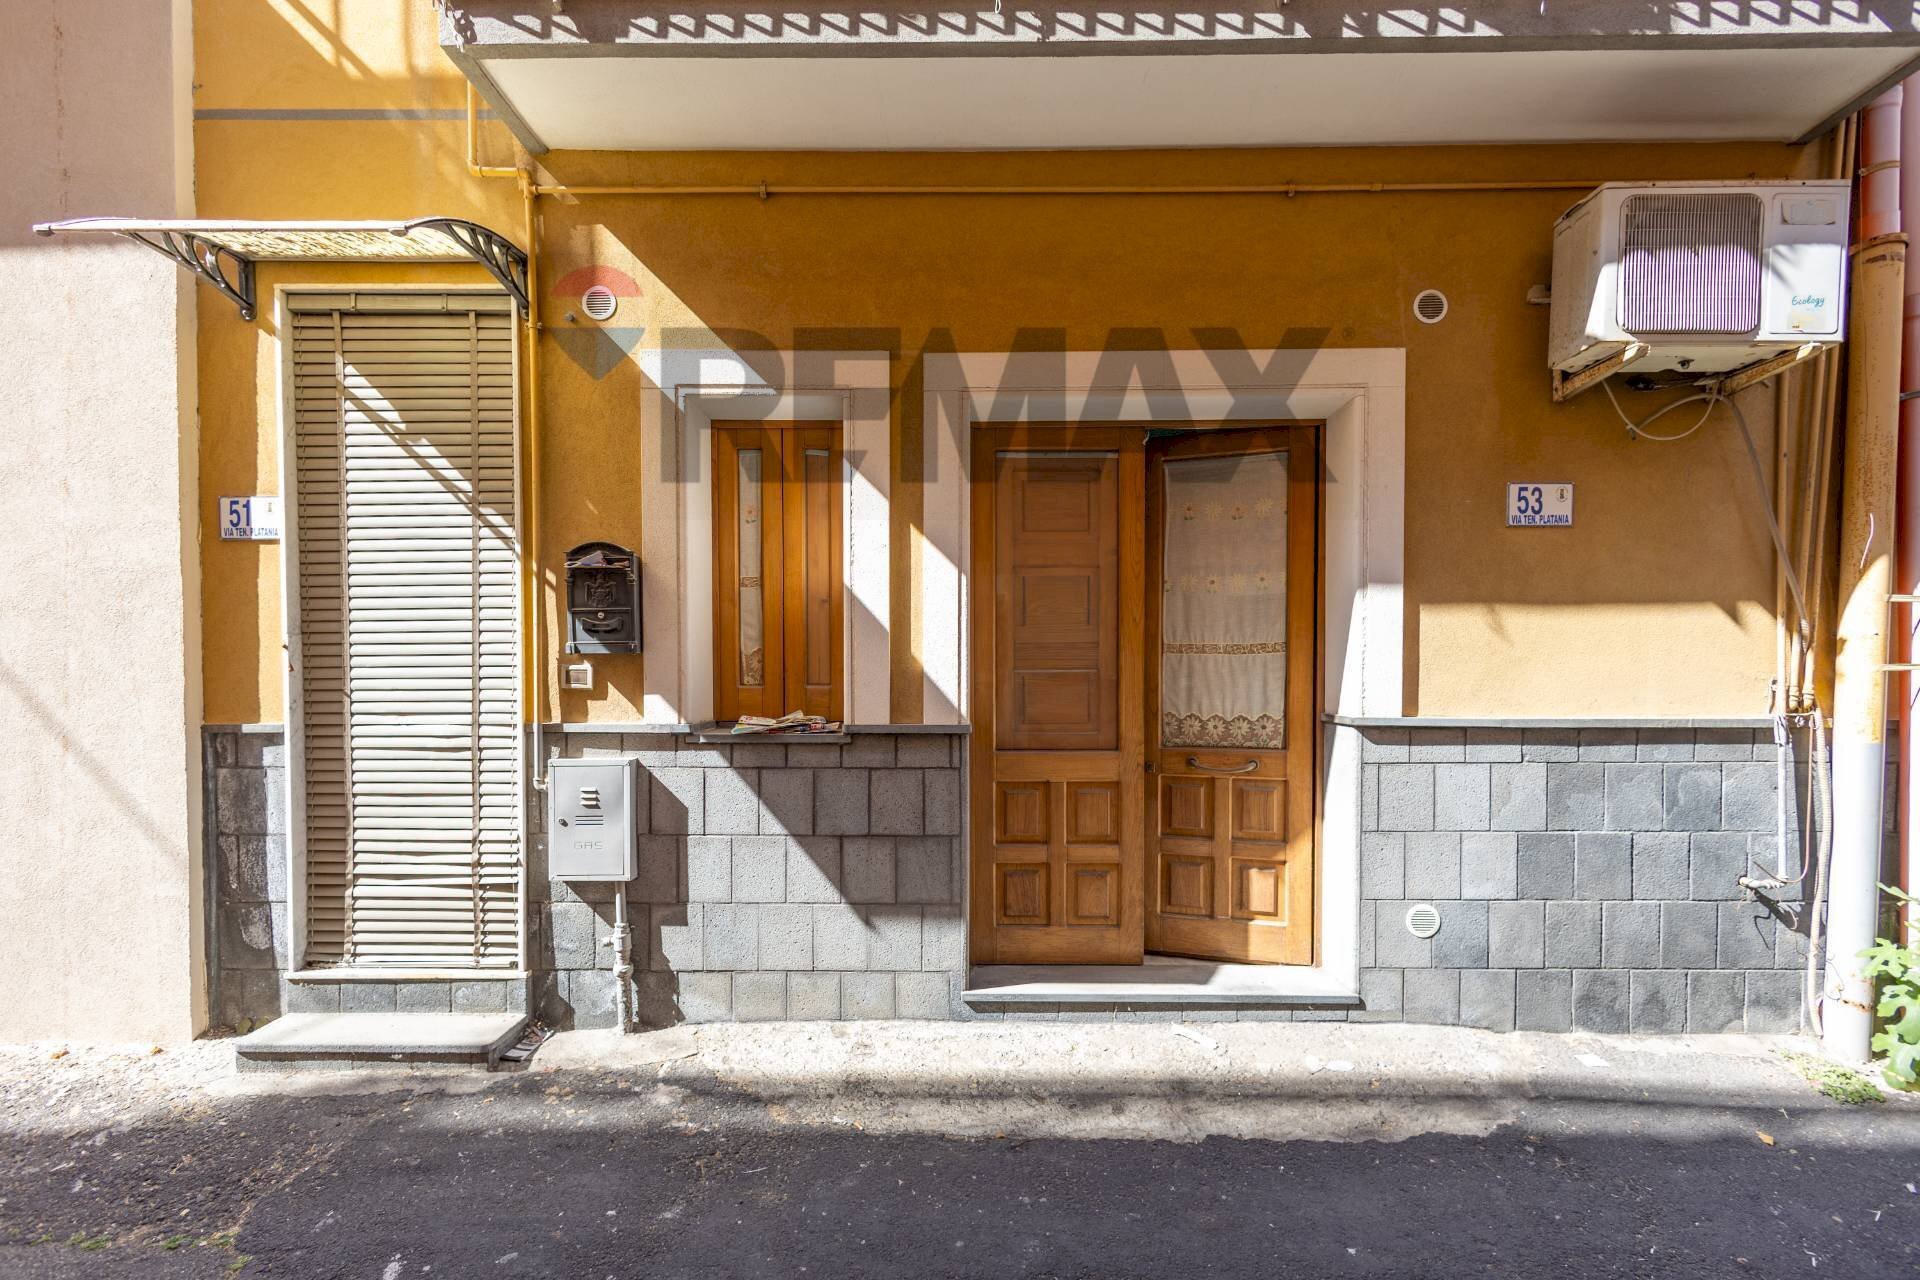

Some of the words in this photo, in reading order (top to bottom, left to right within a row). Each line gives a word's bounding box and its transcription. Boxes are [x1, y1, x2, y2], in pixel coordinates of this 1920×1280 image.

[1791, 295, 1825, 308] Ecology
[1517, 486, 1543, 515] 53
[229, 500, 250, 527] 51
[1511, 514, 1522, 525] VIA
[1523, 514, 1538, 525] TEN.
[1539, 514, 1570, 525] PLATANIA
[223, 527, 235, 537] VIA
[250, 527, 279, 537] PLATANIA
[574, 841, 604, 850] GAS
